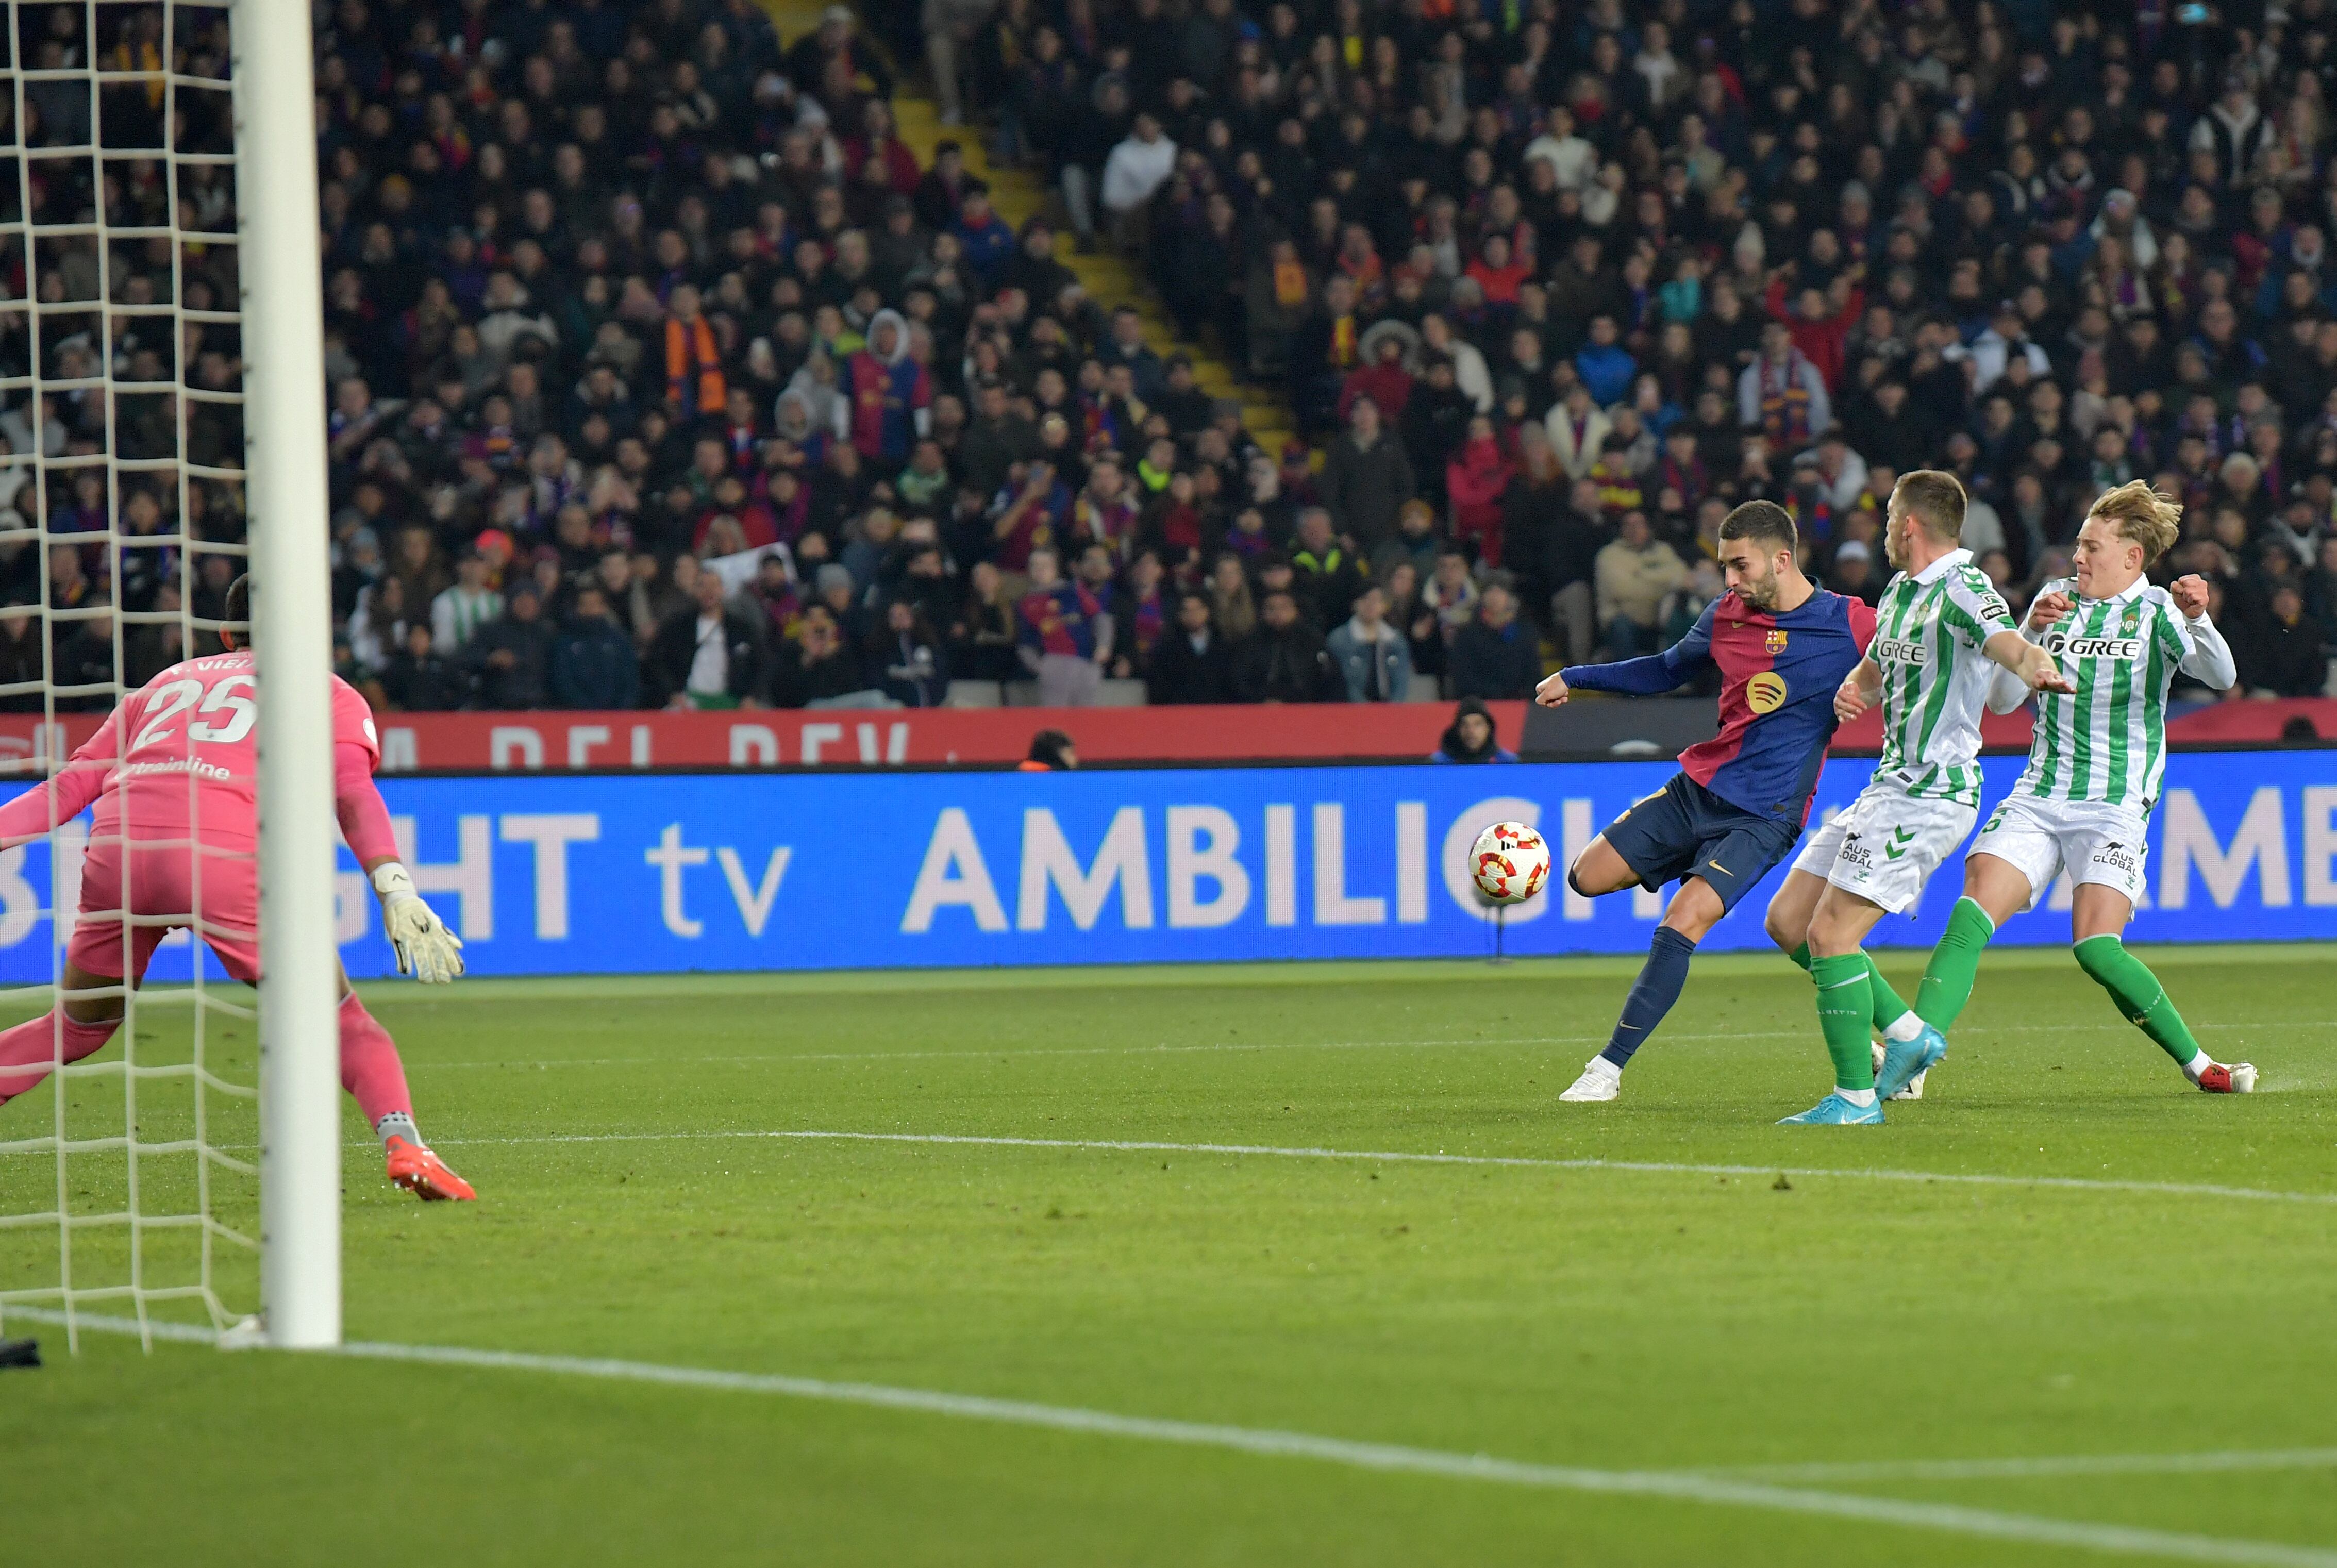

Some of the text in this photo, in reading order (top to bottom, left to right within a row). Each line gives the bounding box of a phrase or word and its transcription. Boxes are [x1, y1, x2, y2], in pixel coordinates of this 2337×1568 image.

[1880, 640, 1925, 663] GREE
[2069, 639, 2140, 657] GREE
[133, 675, 257, 750] 25
[1845, 842, 1872, 858] AUS
[2111, 850, 2135, 865] AUS
[2093, 855, 2137, 877] GLOBAL
[645, 822, 792, 938] tv
